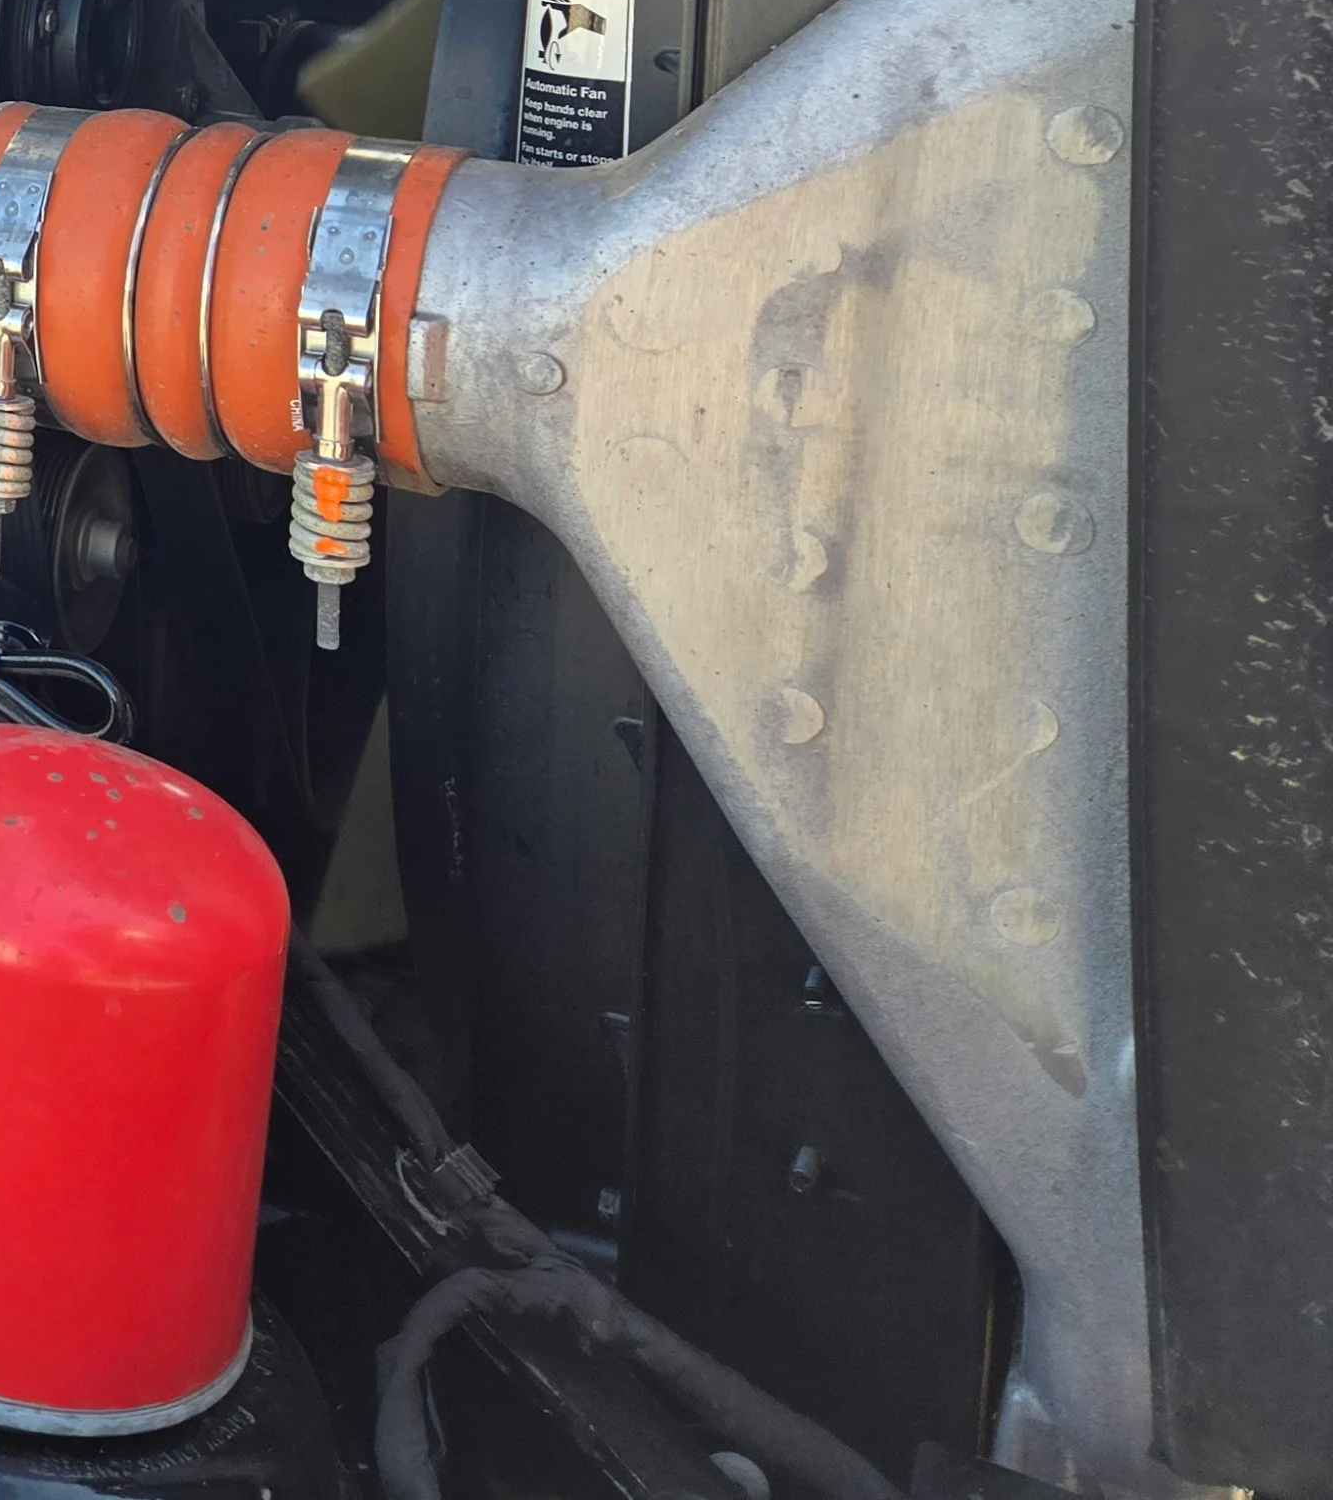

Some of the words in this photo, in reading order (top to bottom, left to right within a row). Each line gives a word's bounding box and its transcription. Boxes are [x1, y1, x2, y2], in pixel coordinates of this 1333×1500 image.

[525, 78, 578, 97] Automatic
[580, 86, 607, 100] Fan
[524, 97, 543, 111] Keep
[544, 101, 575, 115] hands
[577, 107, 608, 119] clear
[523, 111, 543, 123] when
[544, 116, 579, 130] engine
[581, 120, 593, 131] is
[521, 141, 534, 153] Fan
[535, 146, 564, 160] starts
[565, 153, 579, 162] or
[289, 399, 305, 432] CHINA
